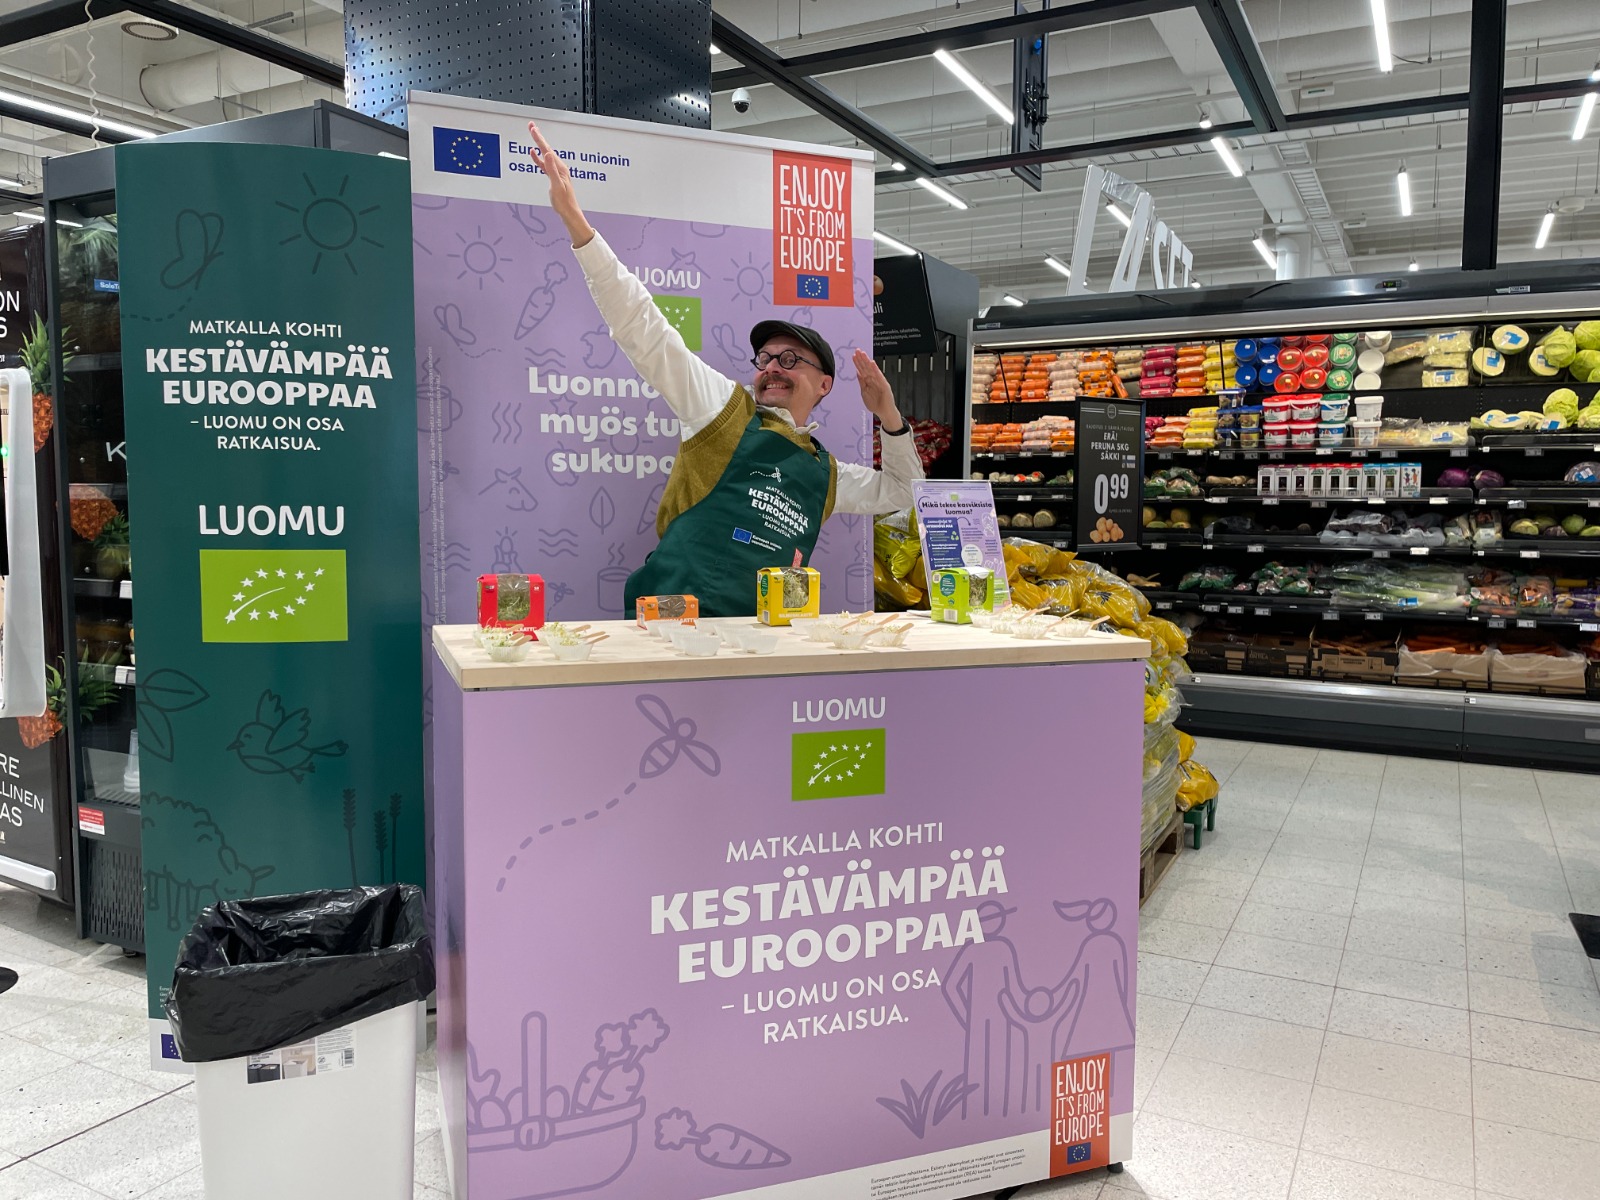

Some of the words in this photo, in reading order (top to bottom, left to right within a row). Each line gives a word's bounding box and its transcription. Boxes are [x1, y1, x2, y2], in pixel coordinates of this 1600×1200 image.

[580, 152, 630, 166] unionin
[780, 164, 845, 210] ENJOY
[780, 206, 804, 236] IT'S
[808, 210, 845, 239] FROM
[780, 236, 845, 272] EUROPE
[630, 265, 700, 289] UOMU
[190, 320, 280, 336] MATKALLA
[286, 322, 342, 338] KOHTI
[146, 340, 392, 378] KESTÄVÄMPÄÄ
[163, 380, 376, 408] EUROOPPAA
[204, 416, 267, 430] LUOMU
[272, 416, 300, 430] ON
[306, 418, 344, 432] OSA
[541, 406, 637, 442] myös
[1104, 431, 1118, 440] ERÄ!
[218, 436, 320, 451] RATKAISUA.
[1091, 442, 1116, 450] PERUNA
[1117, 443, 1130, 451] 5KG
[1100, 450, 1120, 460] SÄKKI
[199, 505, 345, 536] LUOMU
[748, 488, 808, 528] KESTÄVÄMPÄÄ
[752, 499, 804, 534] EUROOPPAA
[792, 697, 886, 723] LUOMU
[0, 781, 44, 813] LINEN
[726, 830, 862, 863] MATKALLA
[869, 822, 944, 848] KOHTI
[650, 846, 1008, 934] KESTÄVÄMPÄÄ
[678, 908, 985, 983] EUROOPPAA
[743, 981, 838, 1014] LUOMU
[845, 974, 886, 998] ON
[891, 967, 942, 992] OSA
[764, 1003, 910, 1044] RATKAISUA.
[1056, 1058, 1106, 1098] ENJOY
[1056, 1096, 1075, 1118] IT'S
[1077, 1090, 1104, 1114] FROM
[1055, 1112, 1104, 1146] EUROPE
